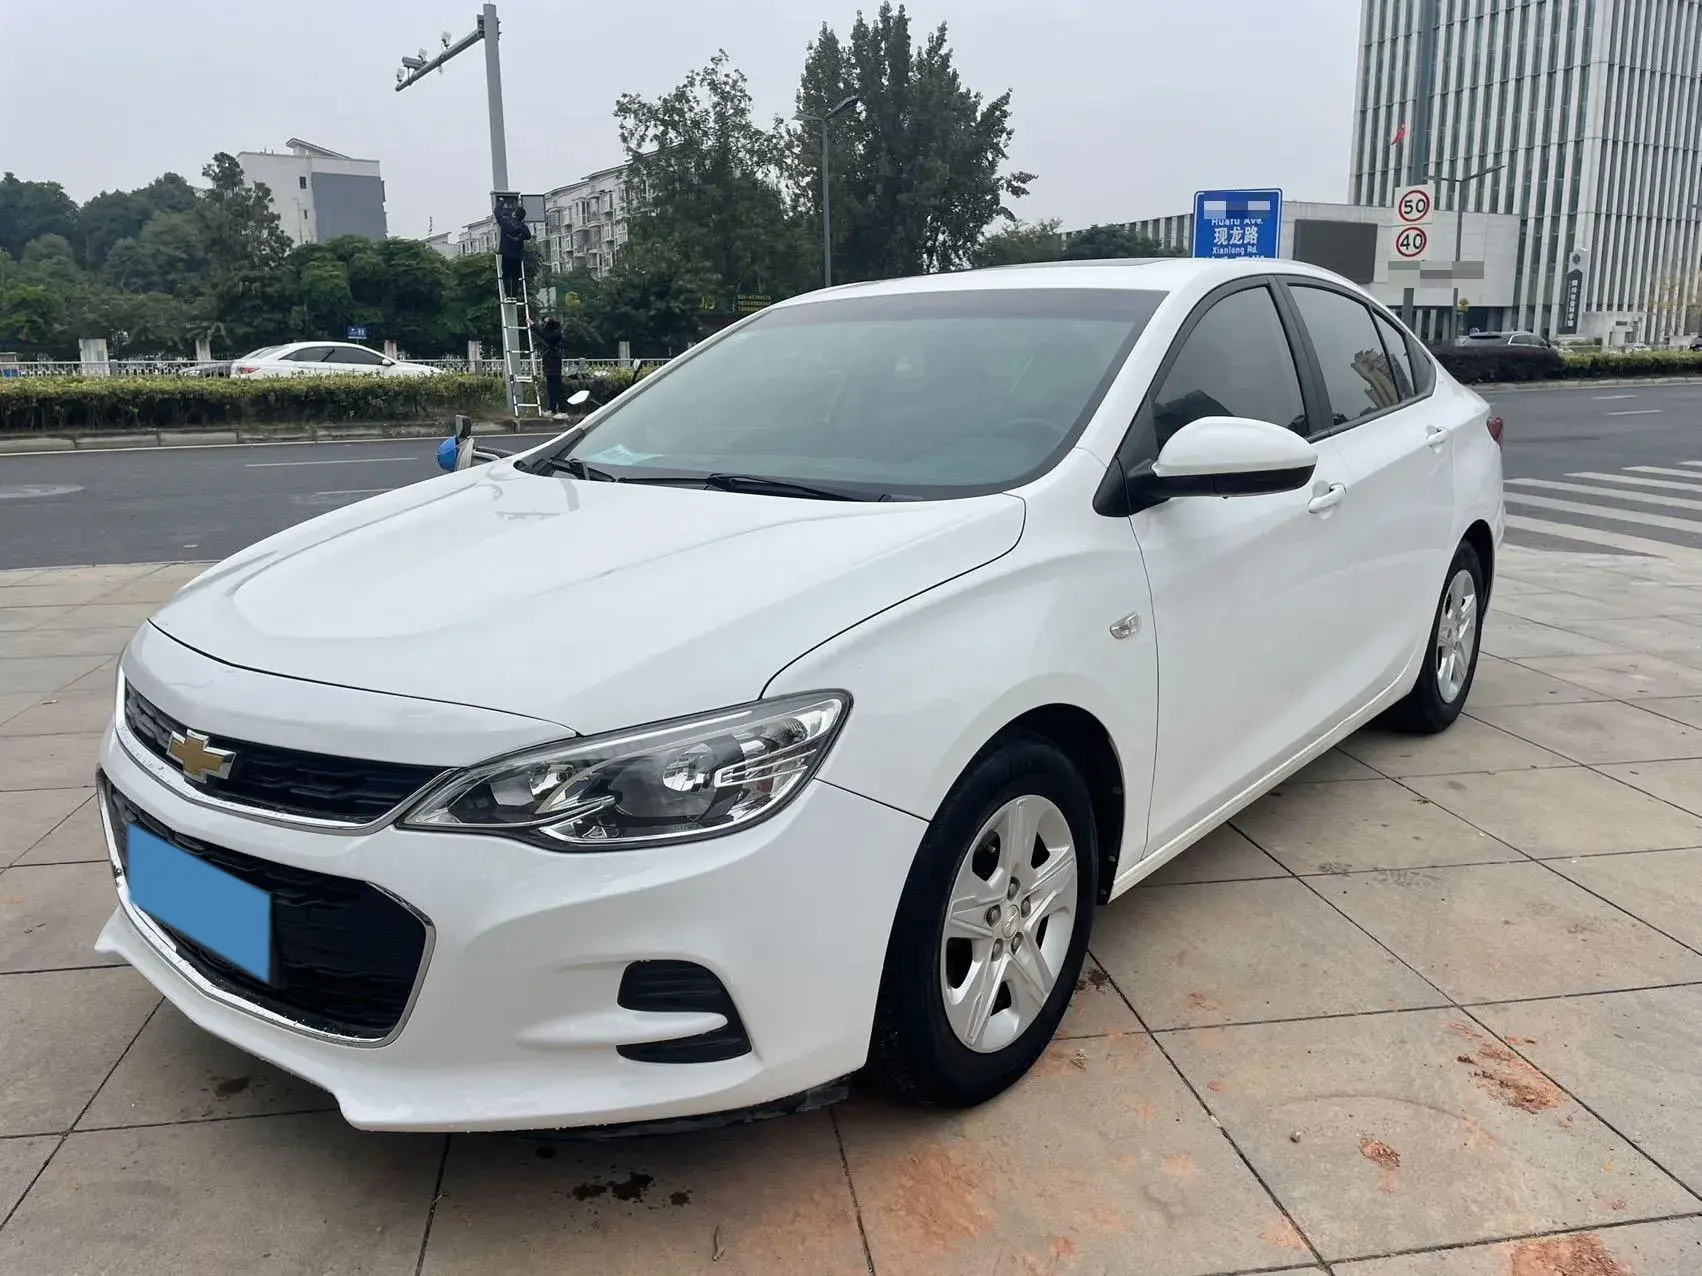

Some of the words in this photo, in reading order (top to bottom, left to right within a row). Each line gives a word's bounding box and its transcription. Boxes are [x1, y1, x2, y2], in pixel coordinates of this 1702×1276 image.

[1404, 199, 1426, 215] 50
[1213, 226, 1259, 245] 现龙路
[1399, 233, 1423, 250] 40
[1212, 246, 1245, 256] Xianlong
[1247, 245, 1258, 254] Rd.
